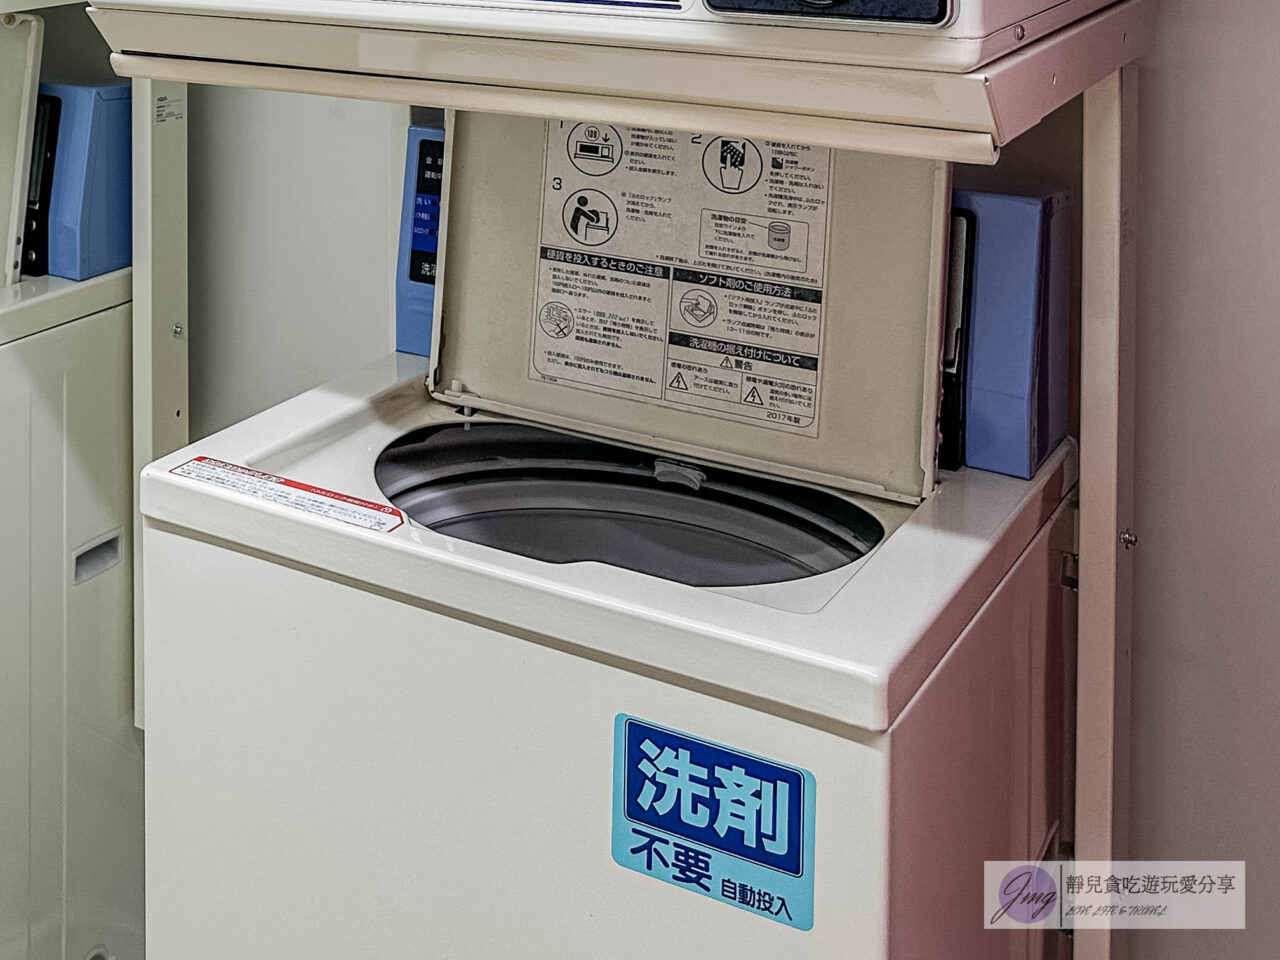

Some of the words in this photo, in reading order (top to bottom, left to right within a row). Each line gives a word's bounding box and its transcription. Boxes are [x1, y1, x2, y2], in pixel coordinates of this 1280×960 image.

[552, 177, 562, 191] 3
[546, 249, 664, 277] 硬貨を投入するときのご注意
[699, 274, 792, 298] ソフト剤のご使用方法
[734, 359, 753, 371] 警告
[636, 738, 789, 855] 洗剤
[630, 827, 712, 892] 不要
[721, 878, 793, 921] 自動投入
